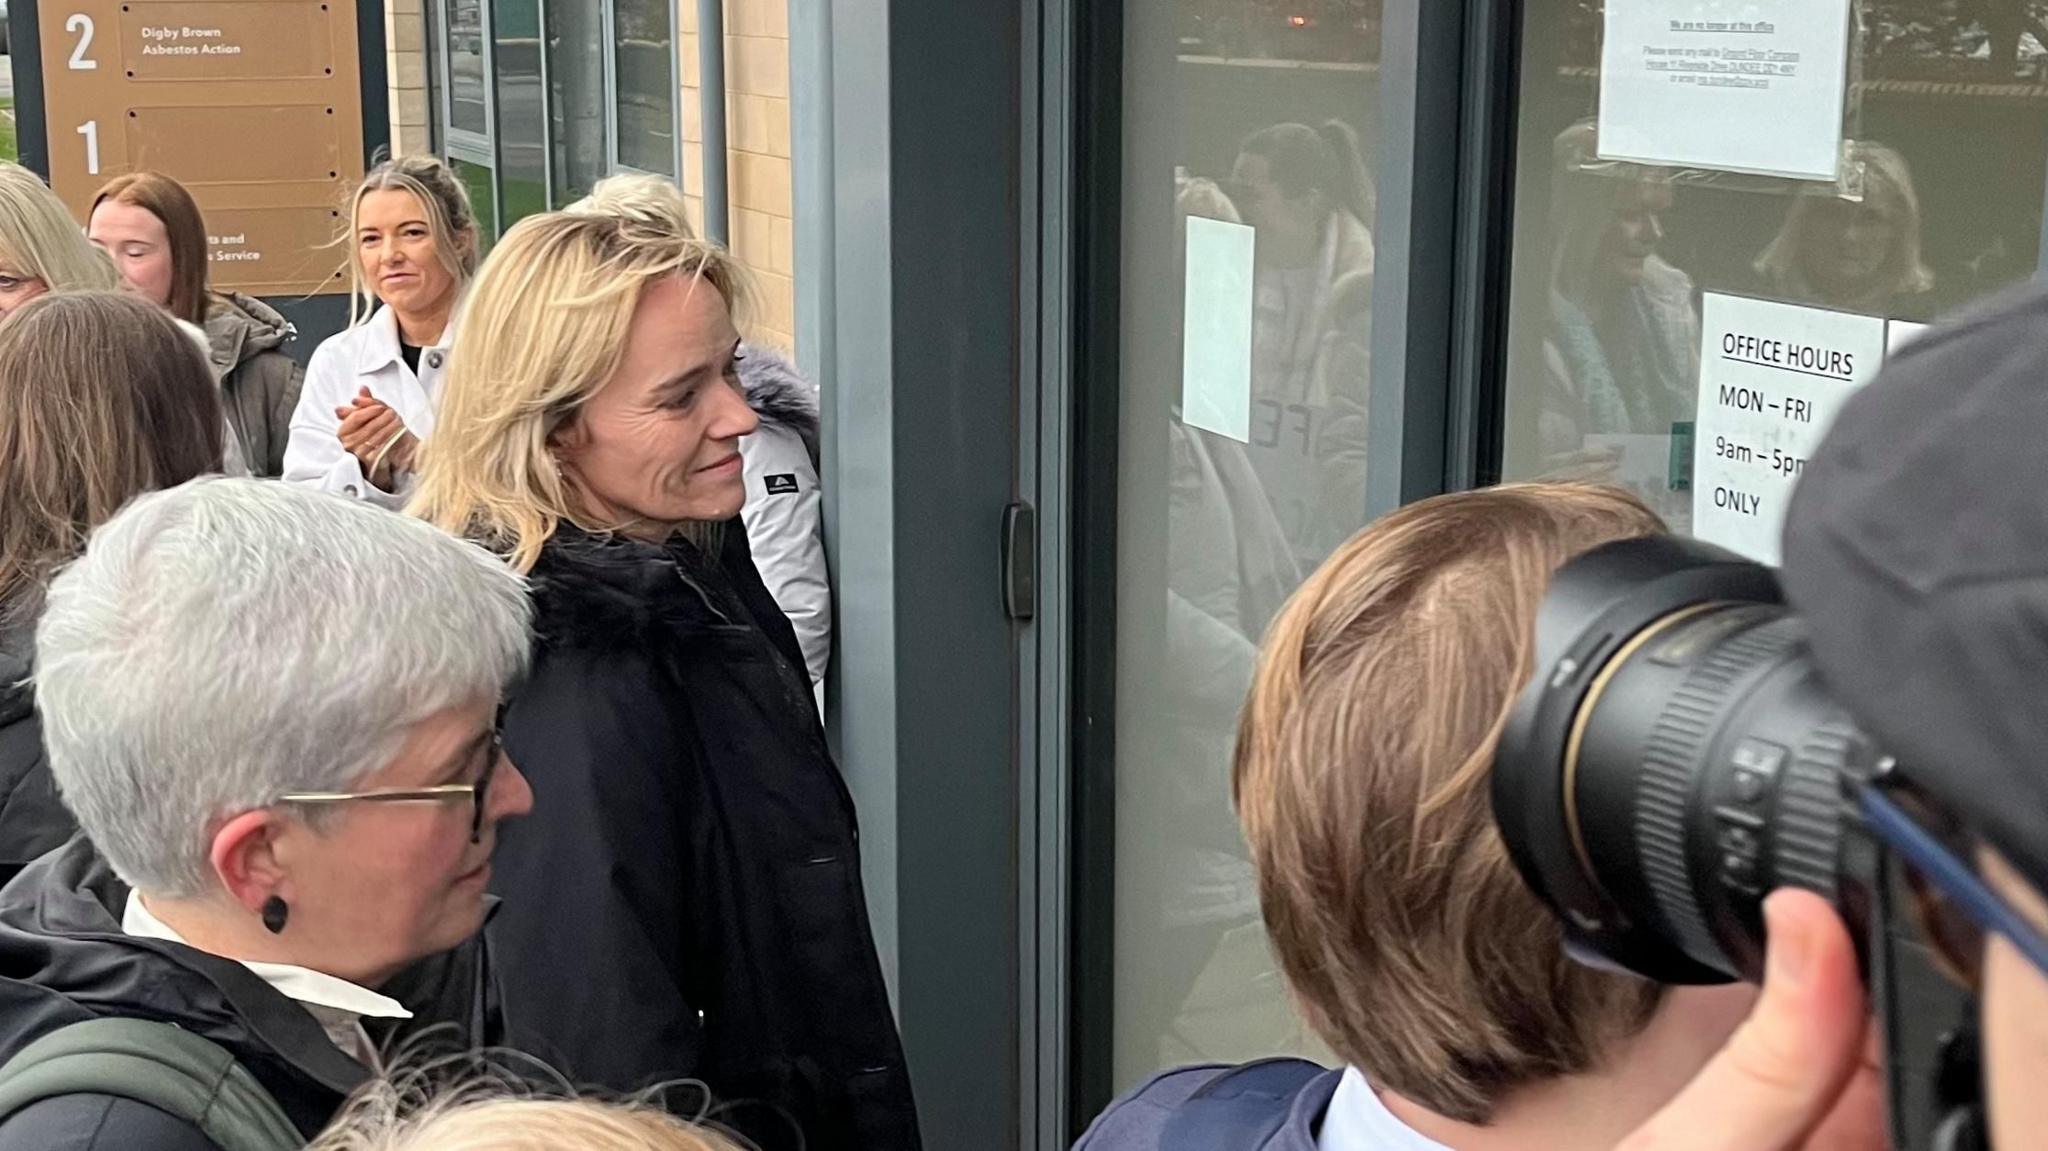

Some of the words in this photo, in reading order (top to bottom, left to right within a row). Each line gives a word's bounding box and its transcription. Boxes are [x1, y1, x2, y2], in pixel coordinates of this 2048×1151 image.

[66, 13, 97, 70] 2
[141, 26, 179, 41] Digby
[181, 26, 221, 38] Brown
[142, 44, 198, 55] Asbestos
[201, 43, 241, 55] Action
[77, 120, 99, 175] 1
[221, 232, 245, 245] and
[216, 250, 261, 261] Service
[1722, 332, 1782, 363] OFFICE
[1787, 343, 1854, 376] HOURS
[1718, 383, 1764, 413] MON
[1784, 397, 1812, 423] FRI
[1715, 435, 1751, 463] 9am
[1714, 486, 1760, 516] ONLY
